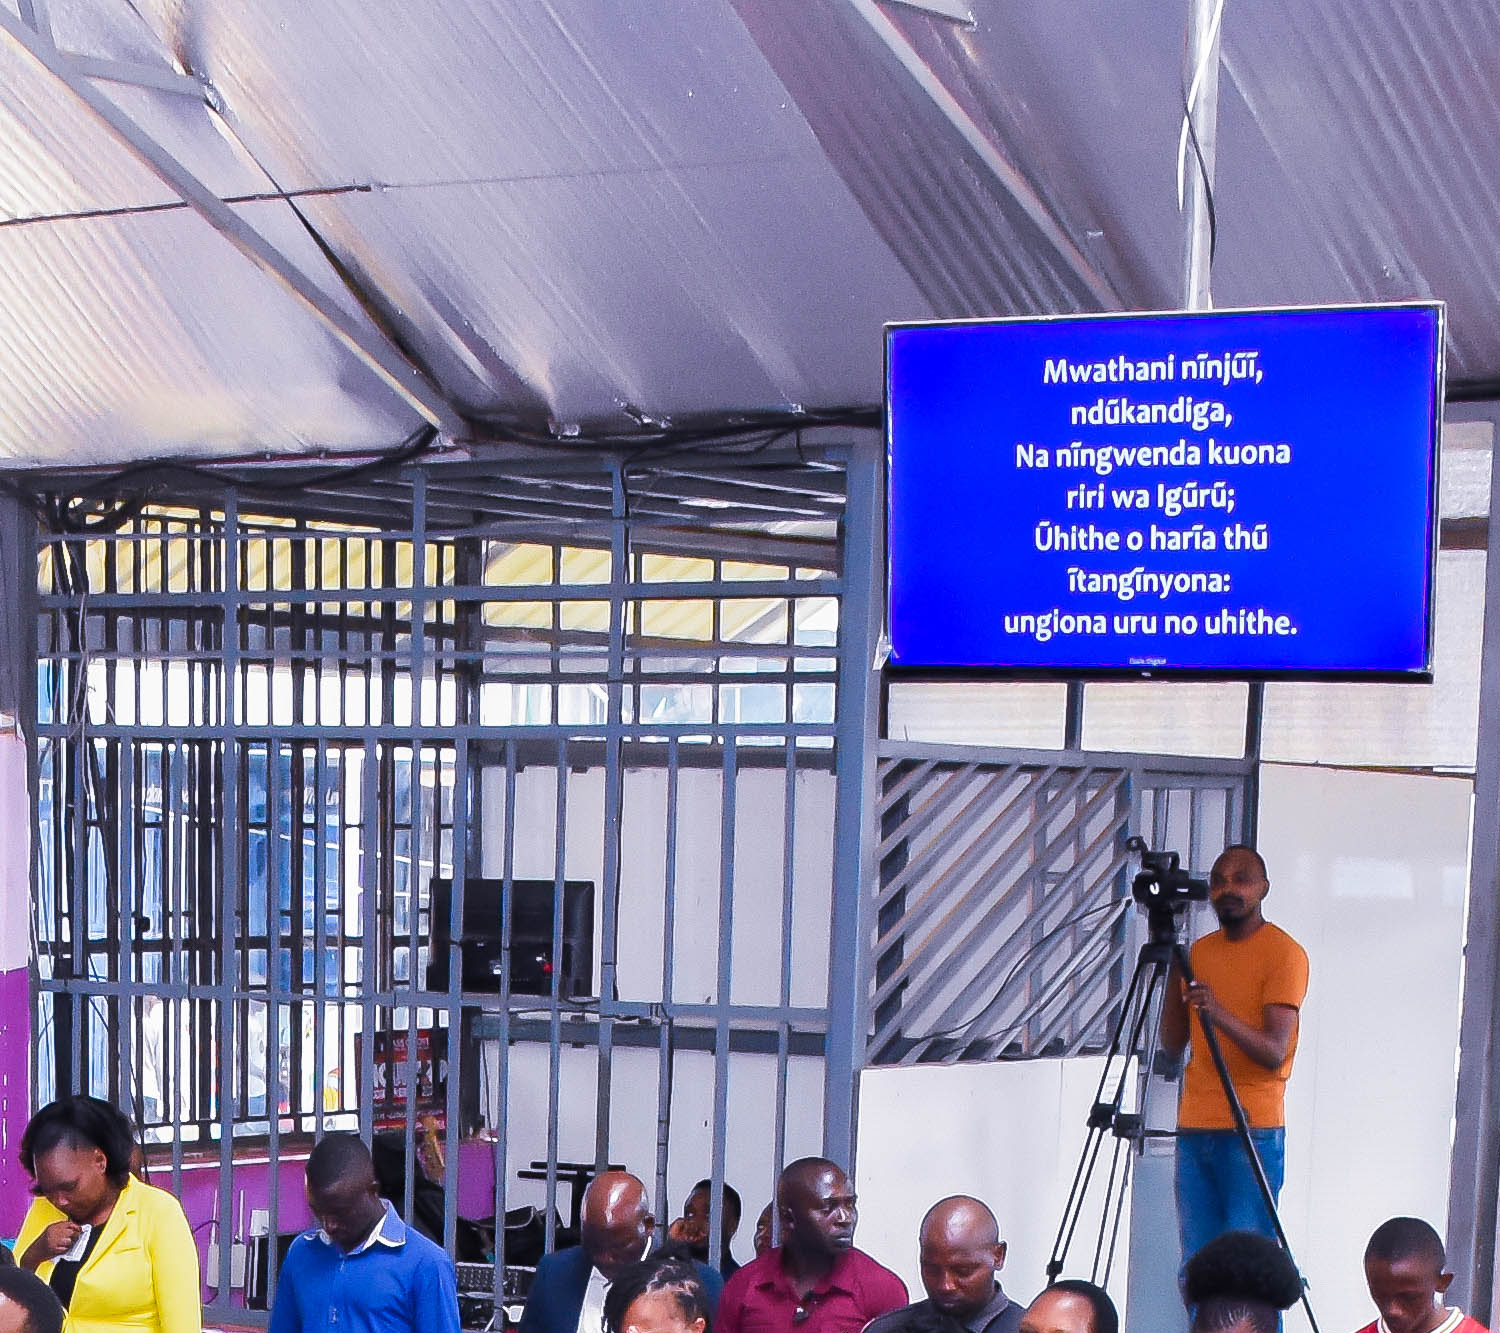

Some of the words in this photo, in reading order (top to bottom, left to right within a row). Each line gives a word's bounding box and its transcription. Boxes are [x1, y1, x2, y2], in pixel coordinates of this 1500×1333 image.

[1043, 354, 1175, 384] Mwathani
[1016, 443, 1049, 468] Na
[1208, 437, 1291, 465] kuona
[1066, 482, 1105, 509] riri
[1111, 488, 1150, 509] wa
[1126, 530, 1144, 551] o
[1004, 608, 1107, 642] ungiona
[1113, 615, 1157, 635] uru
[1164, 615, 1199, 635] no
[1204, 608, 1298, 636] uhithe.
